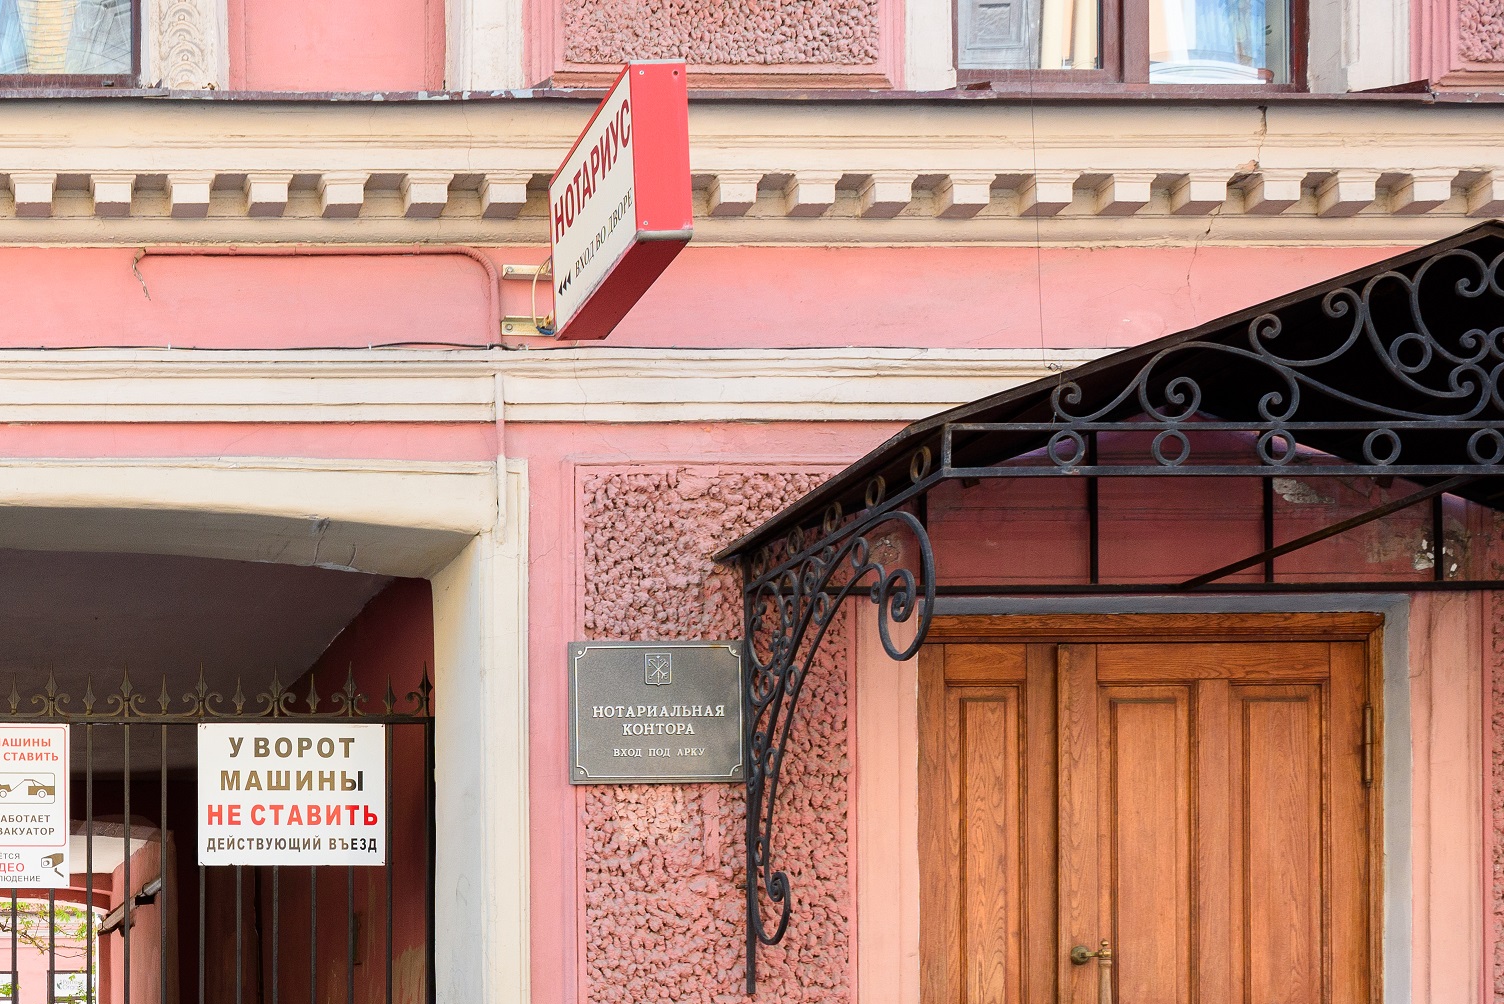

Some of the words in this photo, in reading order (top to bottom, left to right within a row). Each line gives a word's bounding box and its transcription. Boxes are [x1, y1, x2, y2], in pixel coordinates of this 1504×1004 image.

[554, 98, 630, 245] НОТАРИУС
[574, 251, 594, 278] ВХОД
[596, 225, 606, 253] ВО
[607, 187, 633, 238] ДВОРЕ
[592, 705, 725, 718] НОТАРИАЛЬНАЯ
[622, 723, 695, 736] КОНТОРА
[3, 752, 59, 761] СТАВИТЬ
[228, 737, 244, 758] У
[254, 737, 355, 758] ВОРОТ
[613, 748, 642, 757] ВХОД
[648, 748, 671, 757] ПОД
[677, 747, 706, 757] АРКУ
[220, 770, 364, 791] МАШИНЫ
[207, 804, 241, 825] НЕ
[250, 804, 378, 826] СТАВИТЬ
[207, 835, 321, 853] ДЕЙСТВУЮЩИЙ
[328, 838, 377, 853] ВЪЕЗД
